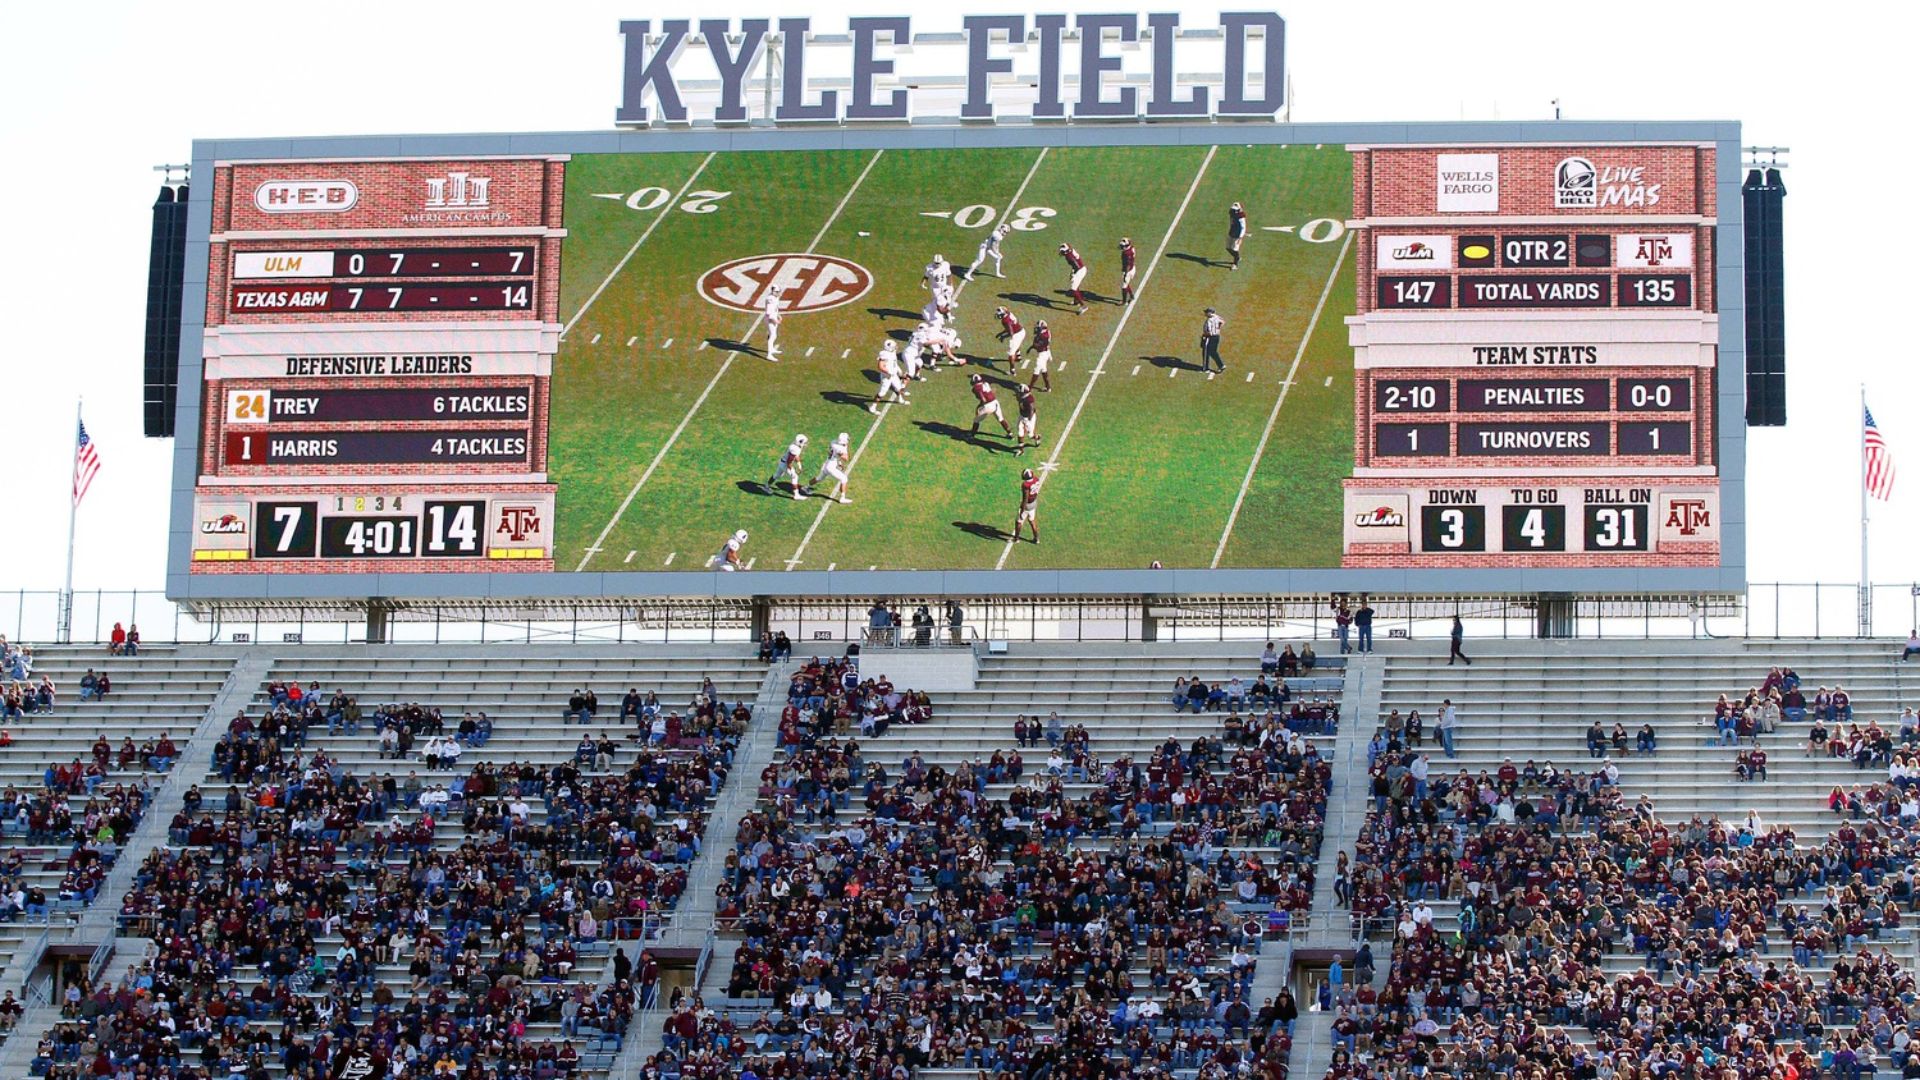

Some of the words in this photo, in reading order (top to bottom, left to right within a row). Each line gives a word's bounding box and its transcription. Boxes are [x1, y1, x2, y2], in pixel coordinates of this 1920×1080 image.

[616, 17, 912, 121] KYLE
[961, 12, 1286, 120] FIELD
[1442, 171, 1495, 182] WELLS
[268, 187, 346, 204] H-E-B
[1444, 183, 1493, 194] FARGO
[402, 213, 463, 222] AMERICAN
[466, 211, 511, 221] CAMPUS
[1392, 246, 1433, 260] ULM
[1506, 242, 1548, 263] QTR
[1553, 241, 1566, 261] 2
[264, 257, 303, 271] ULM
[349, 255, 364, 275] 0
[389, 254, 404, 274] 7
[510, 252, 525, 272] 7
[713, 258, 859, 309] SEC
[1394, 282, 1435, 303] 147
[1475, 284, 1532, 300] TOTAL
[1537, 283, 1600, 300] YARDS
[1634, 280, 1675, 301] 135
[236, 292, 287, 308] TEXAS
[288, 292, 328, 307] A&M
[349, 289, 363, 309] 7
[388, 288, 402, 308] 7
[502, 287, 527, 307] 14
[286, 356, 385, 375] DEFENSIVE
[391, 355, 472, 374] LEADERS
[1473, 346, 1527, 365] TEAM
[1533, 346, 1597, 364] STATS
[235, 395, 265, 418] 24
[274, 398, 319, 415] TREY
[433, 397, 445, 413] 6
[449, 396, 527, 413] TACKLES
[1385, 386, 1436, 408] 2-10
[1484, 388, 1585, 405] PENALTIES
[1631, 385, 1671, 407] 0-0
[241, 436, 252, 460] 1
[271, 440, 338, 457] HARRIS
[431, 439, 443, 455] 4
[447, 438, 525, 455] TACKLES
[1407, 429, 1418, 451] 1
[1480, 431, 1590, 449] TURNOVERS
[1649, 428, 1660, 449] 1
[337, 497, 344, 511] 1
[356, 497, 365, 511] 2
[375, 497, 385, 511] 3
[392, 497, 403, 511] 4
[1429, 490, 1477, 504] DOWN
[1511, 489, 1532, 504] TO
[1537, 489, 1558, 503] GO
[1584, 489, 1623, 503] BALL
[1629, 489, 1652, 503] ON
[201, 518, 246, 533] ULM
[274, 506, 302, 552] 7
[429, 505, 477, 551] 14
[1354, 512, 1405, 527] ULM
[1441, 508, 1465, 548] 3
[1521, 508, 1545, 548] 4
[1596, 508, 1637, 547] 31
[345, 521, 412, 554] 4:01
